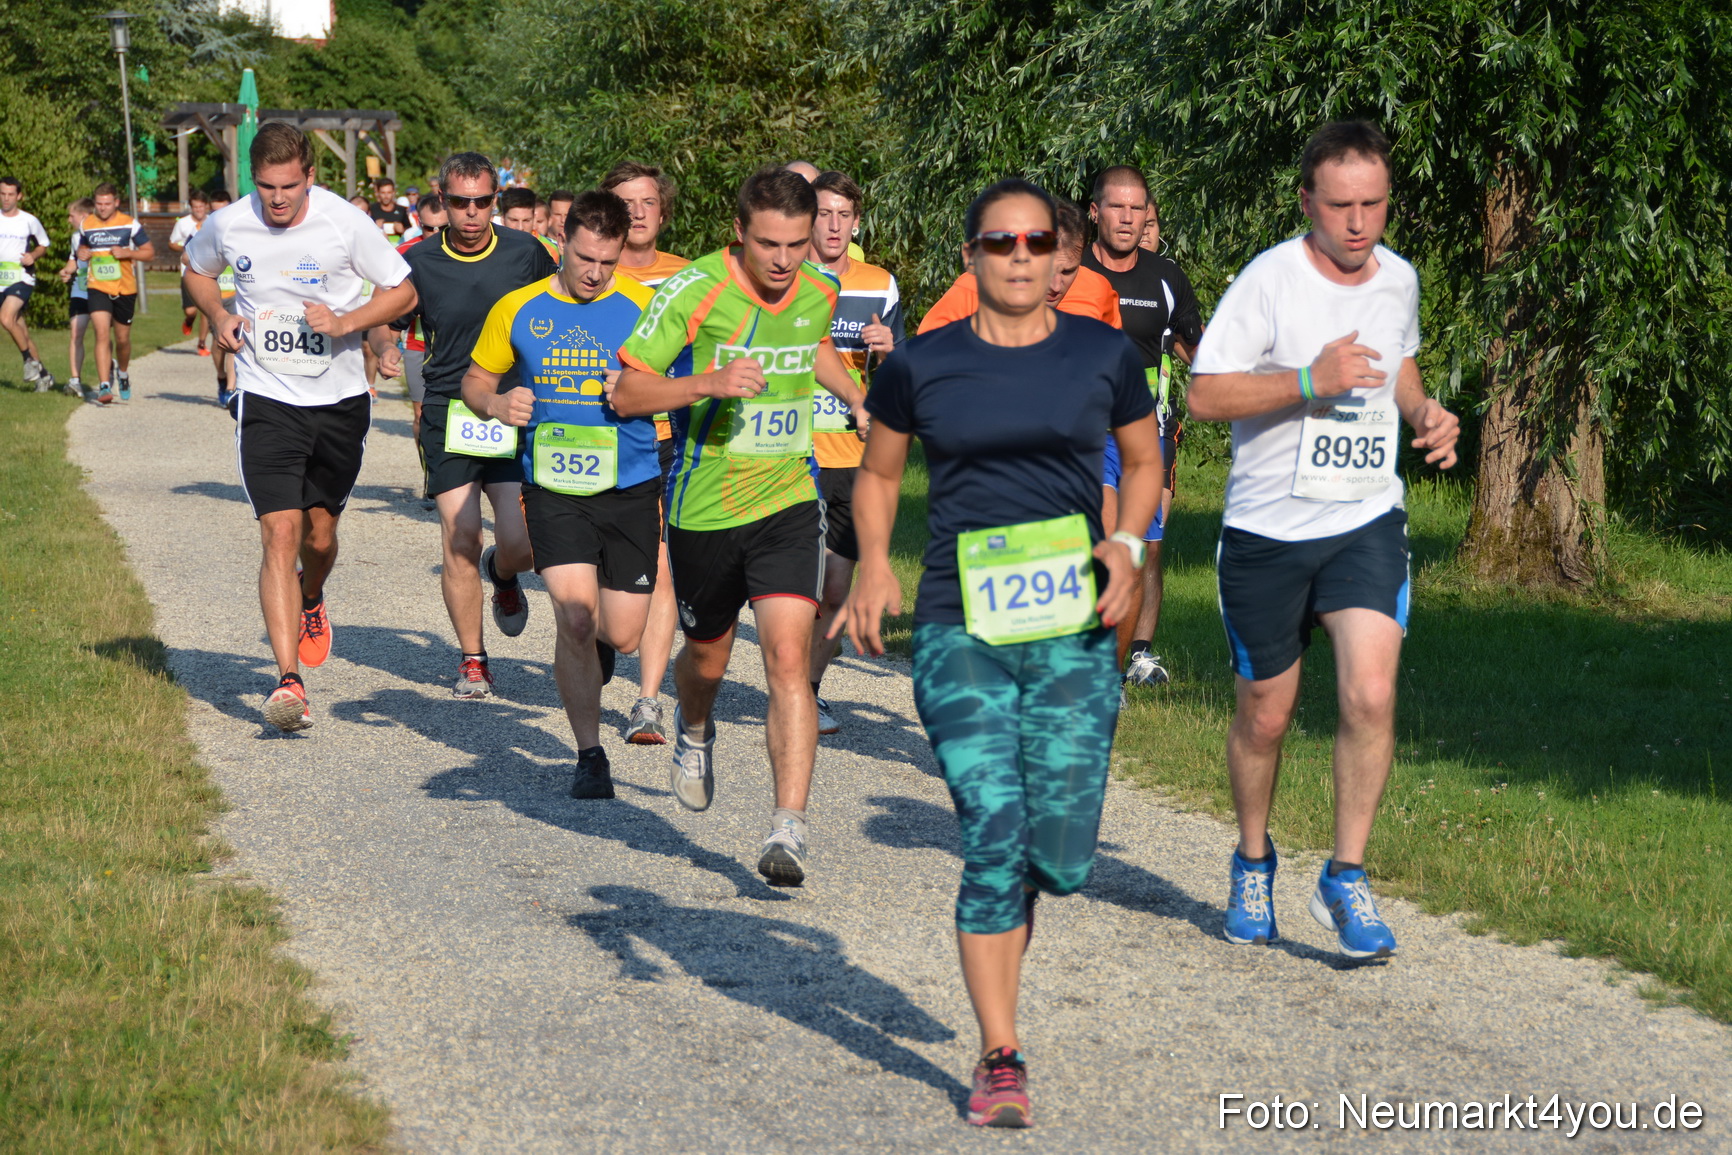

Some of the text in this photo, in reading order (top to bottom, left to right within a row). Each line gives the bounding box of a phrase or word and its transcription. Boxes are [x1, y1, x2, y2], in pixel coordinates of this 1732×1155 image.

[97, 265, 115, 275] 430
[637, 267, 709, 340] BOCK
[1125, 299, 1158, 307] PFLEIDERER
[258, 309, 306, 323] df-spor
[830, 317, 866, 332] cher
[263, 329, 325, 356] 8943
[830, 331, 860, 339] MOBILE
[258, 355, 331, 366] www.df-sports.de
[813, 395, 851, 415] 539
[1311, 405, 1385, 423] df-sports
[461, 421, 503, 443] 836
[750, 408, 799, 437] 150
[1311, 434, 1386, 469] 8935
[551, 452, 600, 477] 352
[1301, 474, 1390, 484] www.df-sports.de
[978, 564, 1082, 612] 1294
